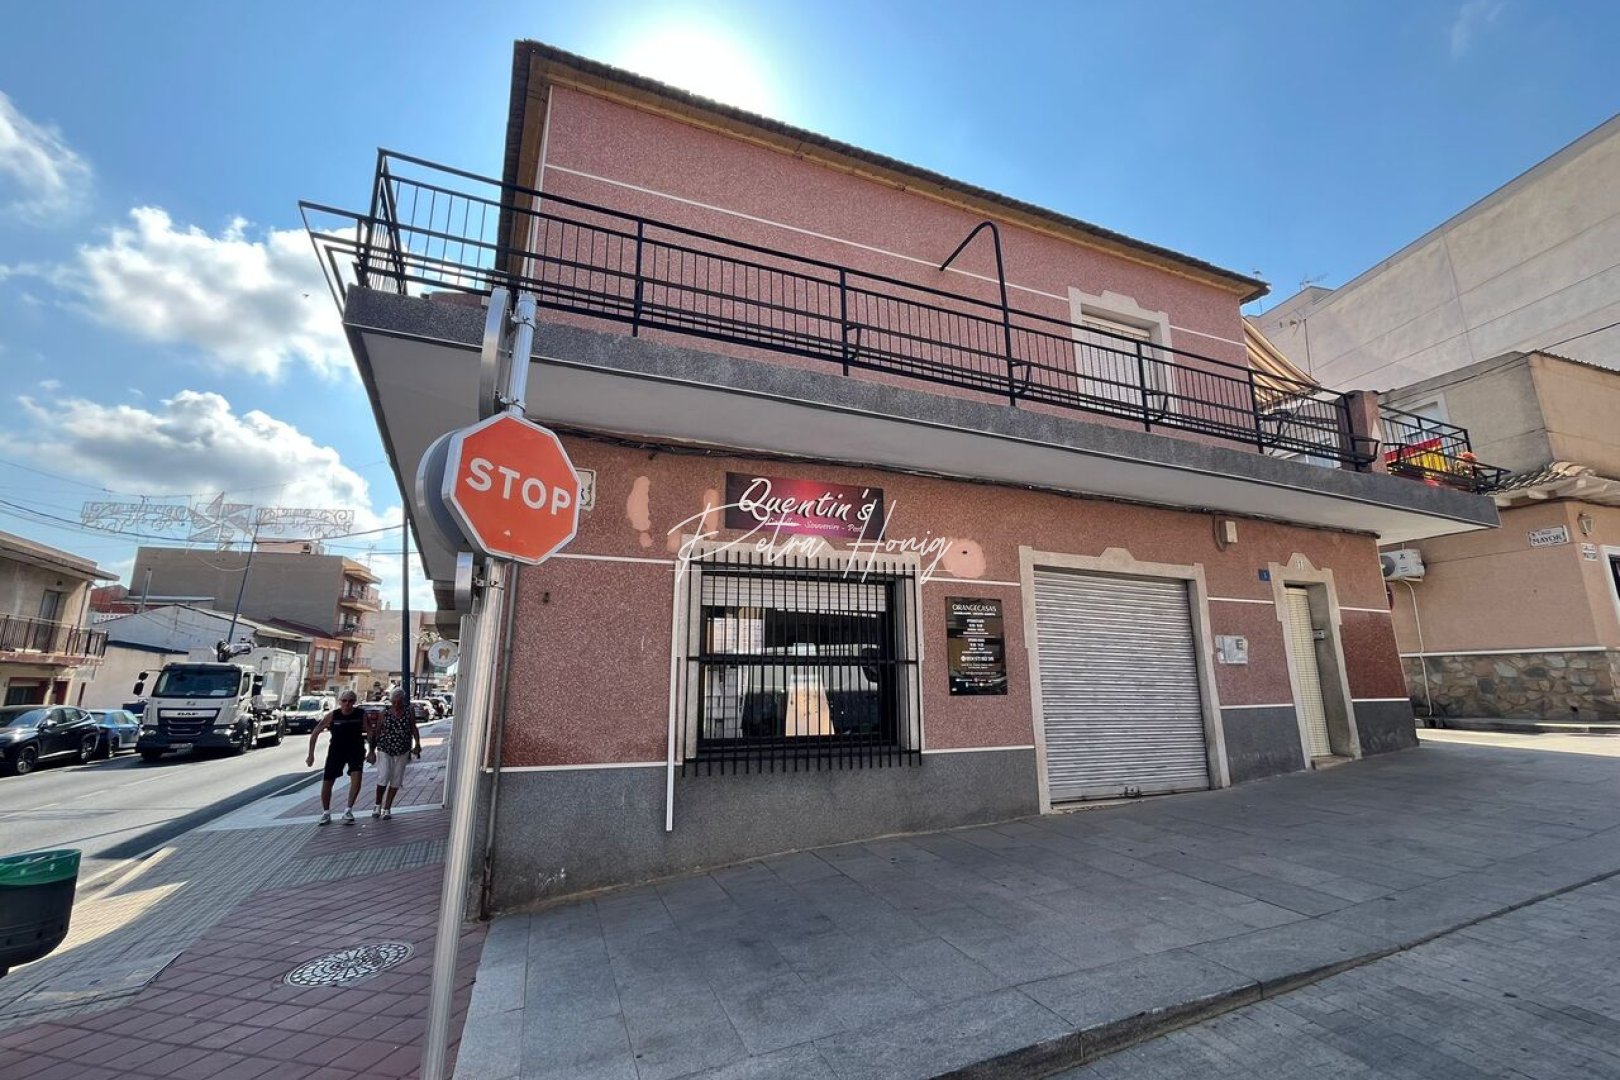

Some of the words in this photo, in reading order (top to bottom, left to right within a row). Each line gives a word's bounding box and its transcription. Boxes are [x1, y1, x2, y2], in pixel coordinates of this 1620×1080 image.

[465, 457, 571, 516] STOP
[739, 477, 877, 521] Quentin's
[1532, 534, 1563, 545] MAYOR
